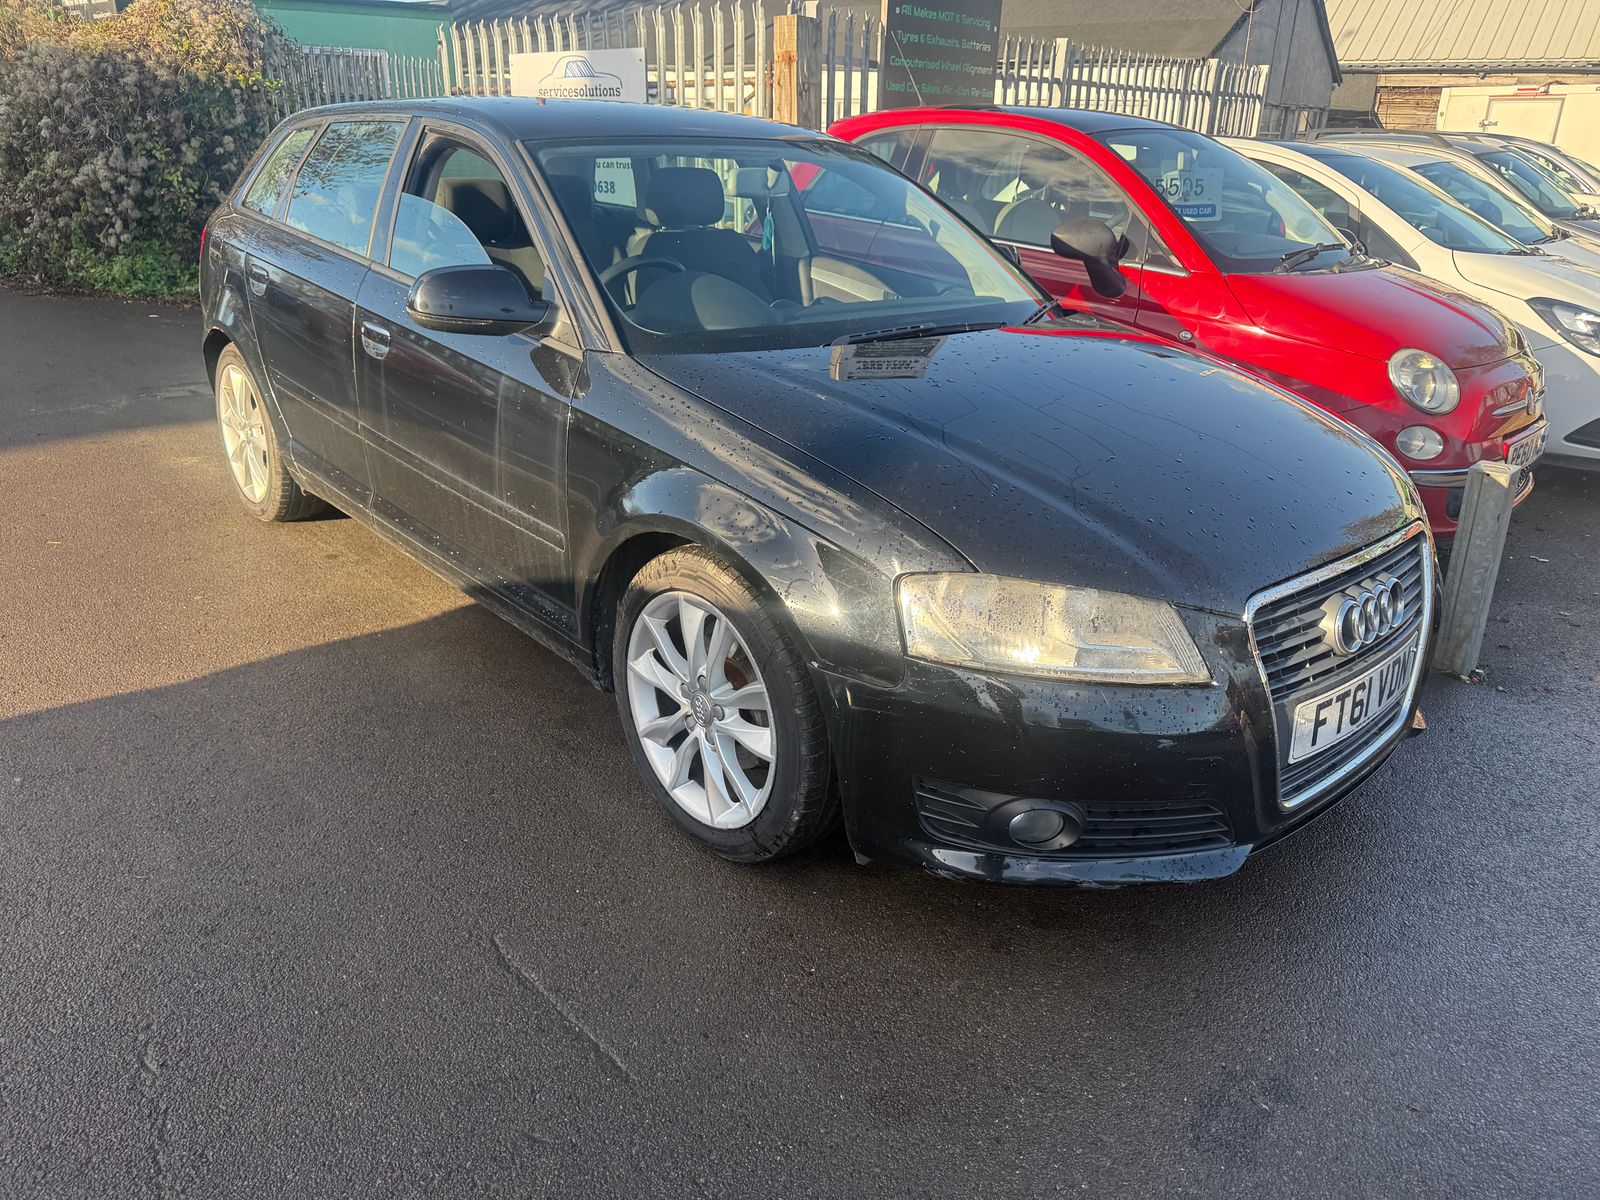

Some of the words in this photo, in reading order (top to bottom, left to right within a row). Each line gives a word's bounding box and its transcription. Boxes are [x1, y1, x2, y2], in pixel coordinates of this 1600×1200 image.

[901, 4, 912, 15] All
[913, 6, 937, 19] Makes
[938, 11, 955, 22] MOT
[961, 14, 991, 30] Servicing
[897, 30, 919, 44] Tyres
[920, 34, 925, 43] &
[961, 39, 991, 52] Batteries
[889, 55, 940, 70] Computerised
[941, 60, 961, 71] Wheel
[963, 63, 993, 76] Alignment
[538, 84, 621, 98] servicesolutions
[885, 80, 905, 92] Used
[943, 85, 953, 95] Air
[602, 161, 615, 169] can
[616, 161, 631, 170] trus
[1182, 207, 1198, 215] USED
[1199, 207, 1212, 215] CAR
[1311, 676, 1374, 747] FT61
